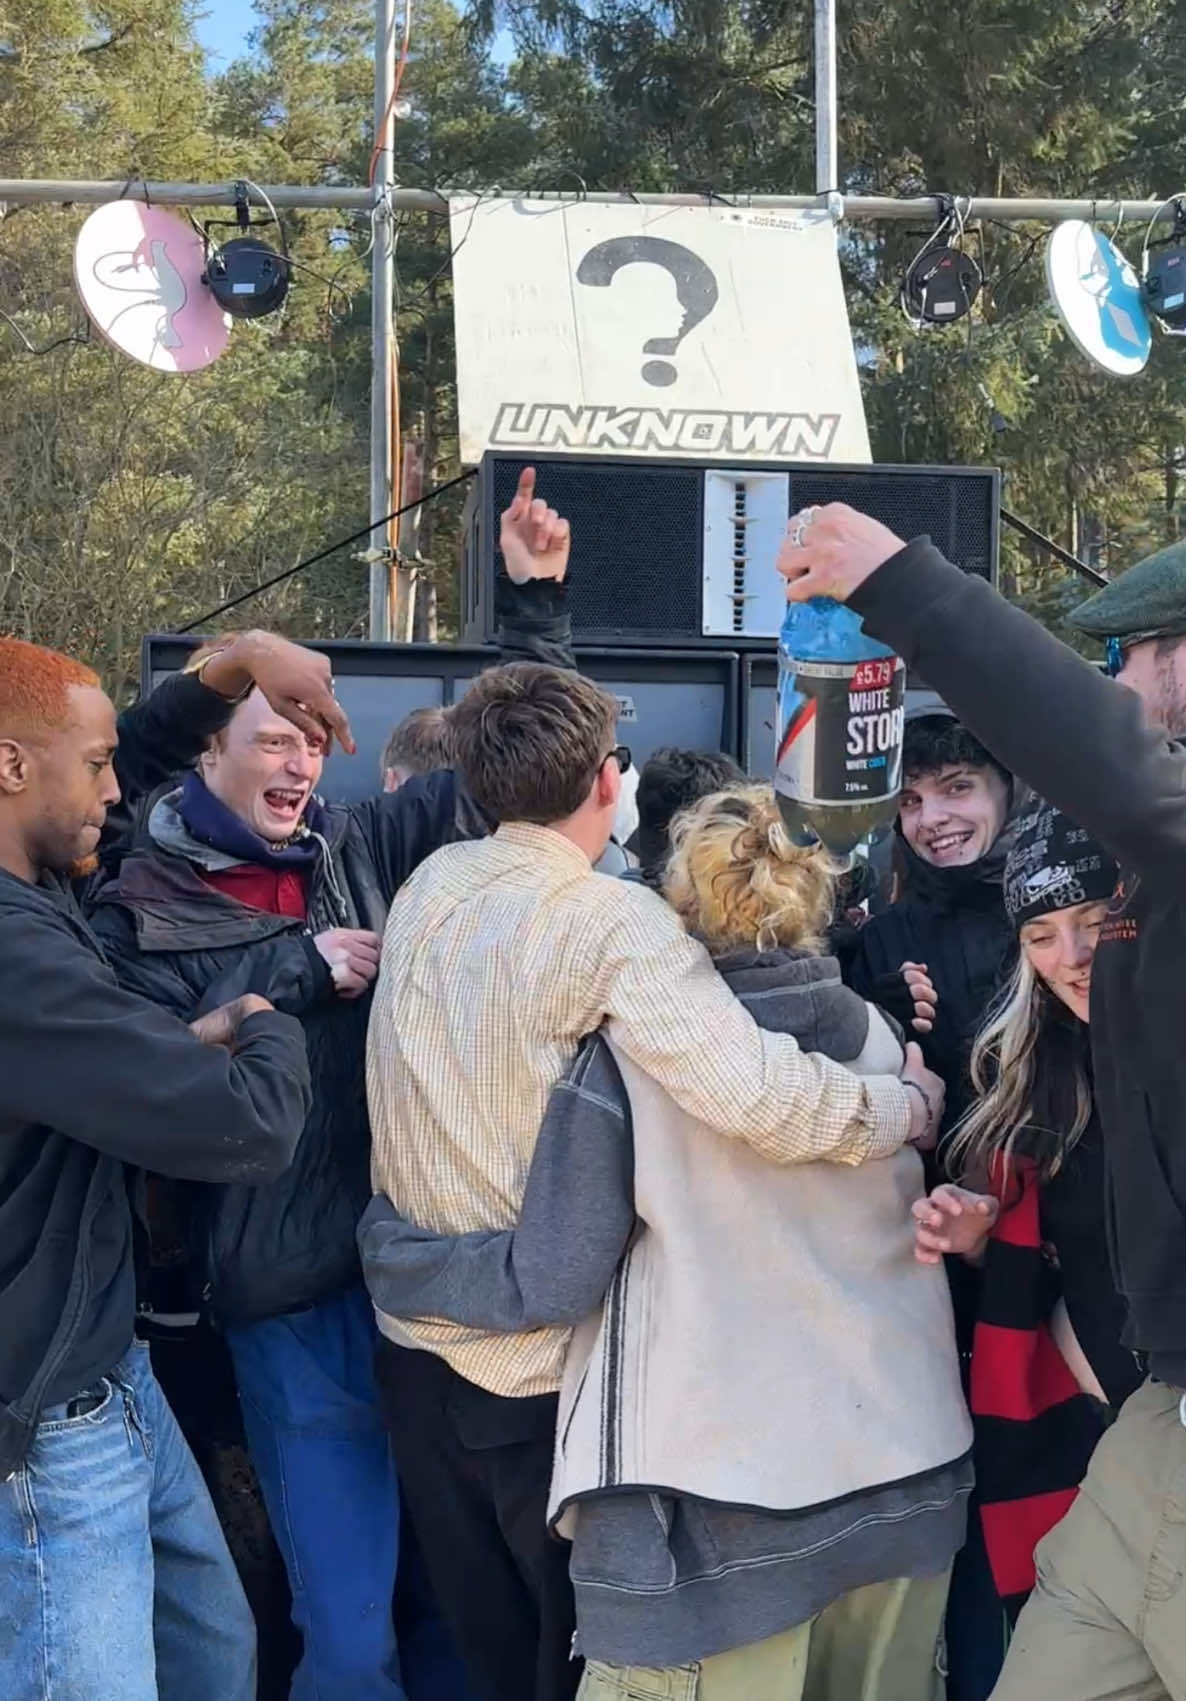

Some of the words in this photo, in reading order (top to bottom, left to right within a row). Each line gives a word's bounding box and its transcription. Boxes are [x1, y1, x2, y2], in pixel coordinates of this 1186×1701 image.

[489, 403, 841, 458] UNKNOWN
[856, 661, 891, 685] £5.79
[848, 689, 890, 712] WHITE
[847, 705, 904, 754] STOR
